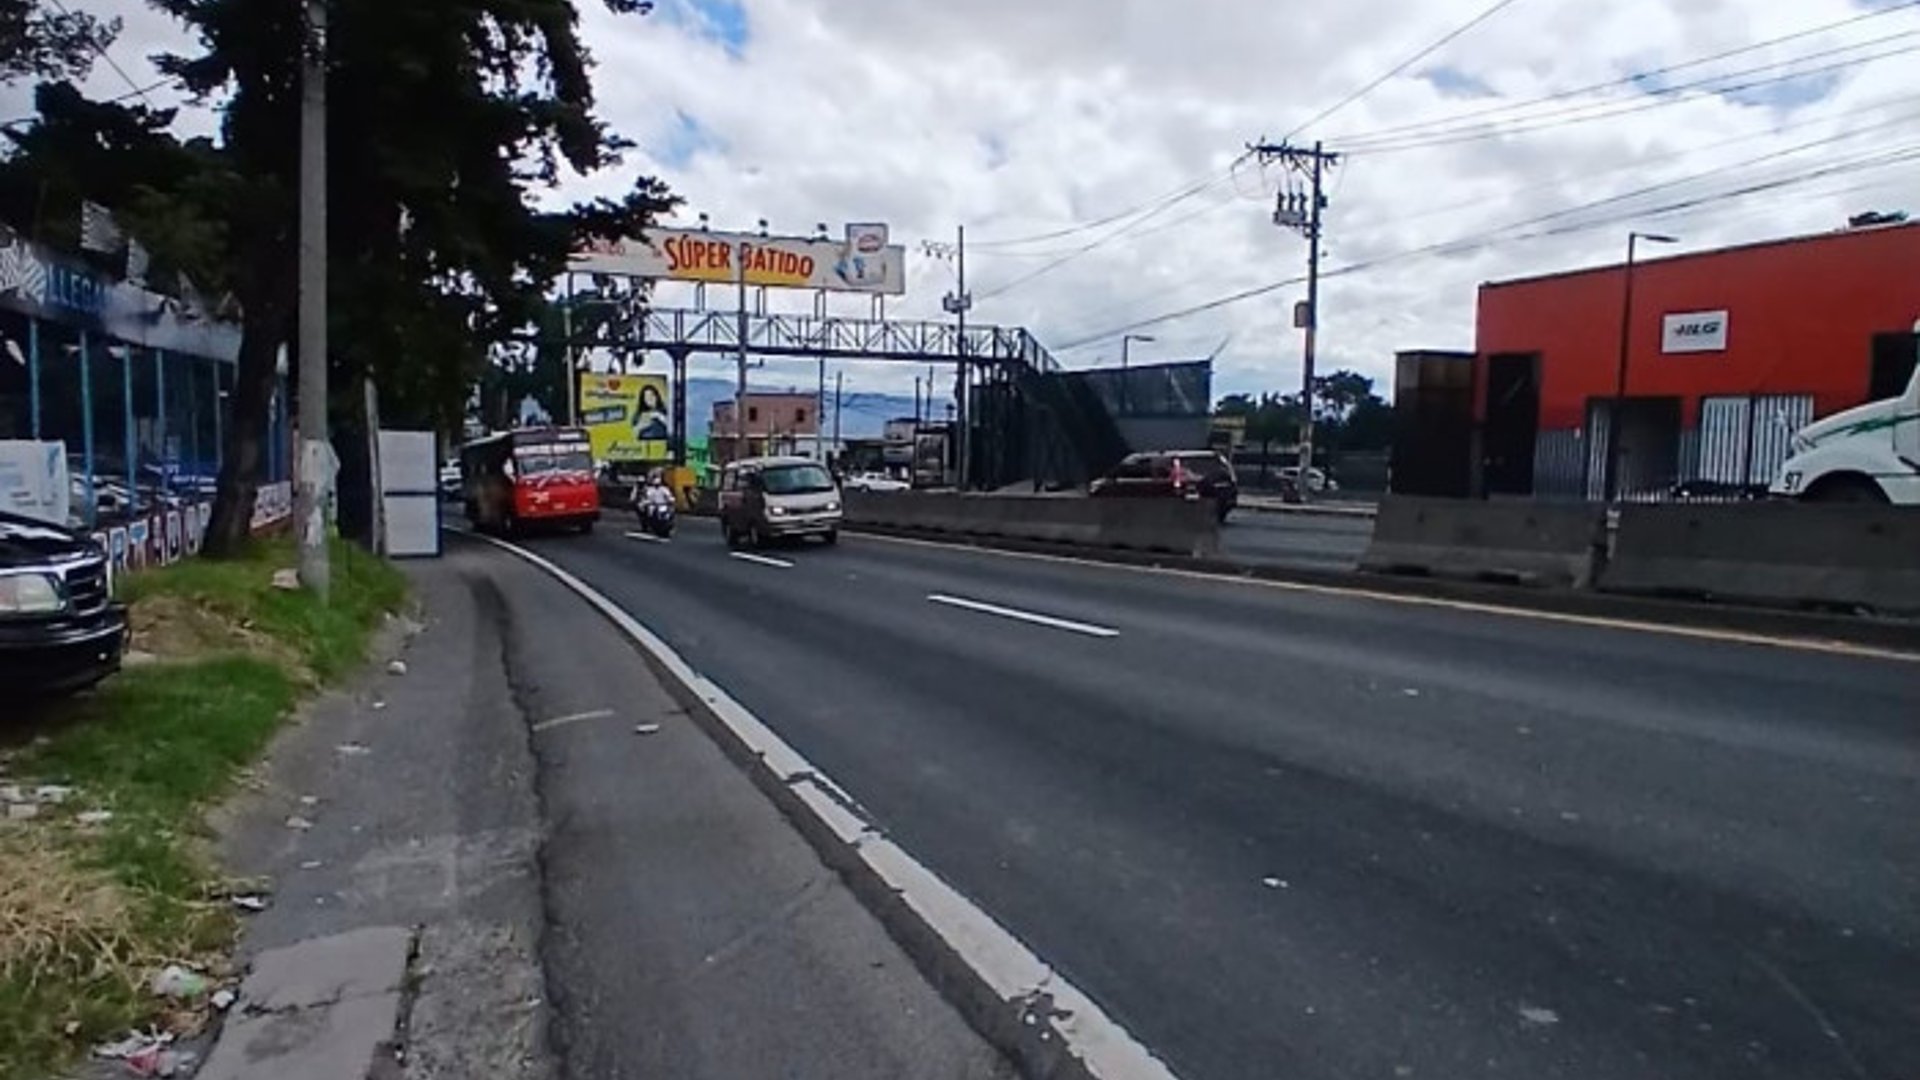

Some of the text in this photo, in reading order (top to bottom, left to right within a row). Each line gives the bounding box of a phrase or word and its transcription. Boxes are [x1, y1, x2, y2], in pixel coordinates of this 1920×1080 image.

[663, 234, 731, 271] SÚPER
[740, 242, 815, 278] BATIDO
[1784, 470, 1803, 491] 97
